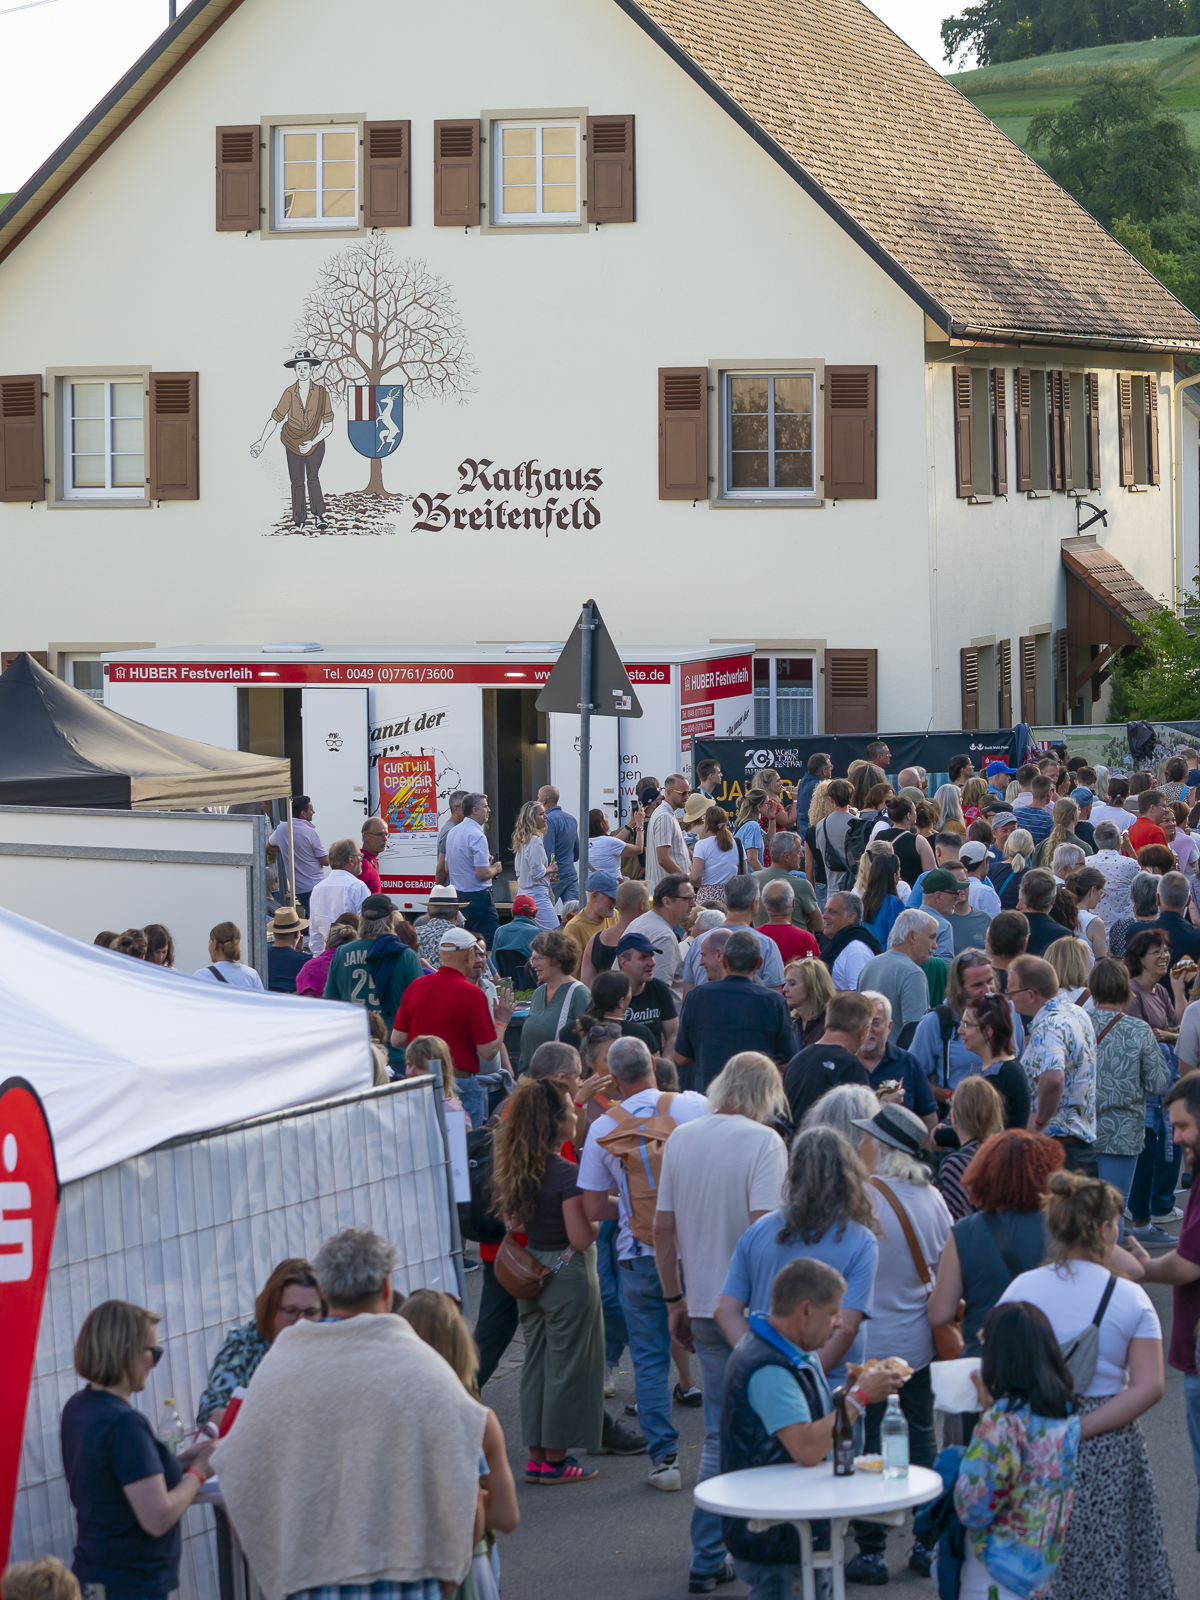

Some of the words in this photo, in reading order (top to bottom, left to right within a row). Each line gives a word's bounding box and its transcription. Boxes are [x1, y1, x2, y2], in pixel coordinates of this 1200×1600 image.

[456, 457, 603, 498] Rathaus
[410, 492, 601, 537] Breitenfeld
[129, 667, 177, 679] HUBER
[181, 667, 253, 679] Festverleih
[323, 668, 343, 680] Tel.
[346, 668, 374, 680] 0049
[377, 668, 454, 682] (0)7761/3600
[691, 672, 715, 690] HUBER
[715, 667, 749, 687] Festverleih
[370, 717, 411, 741] anzt
[414, 712, 445, 732] der
[344, 949, 368, 967] JAM
[623, 1007, 660, 1022] Denim
